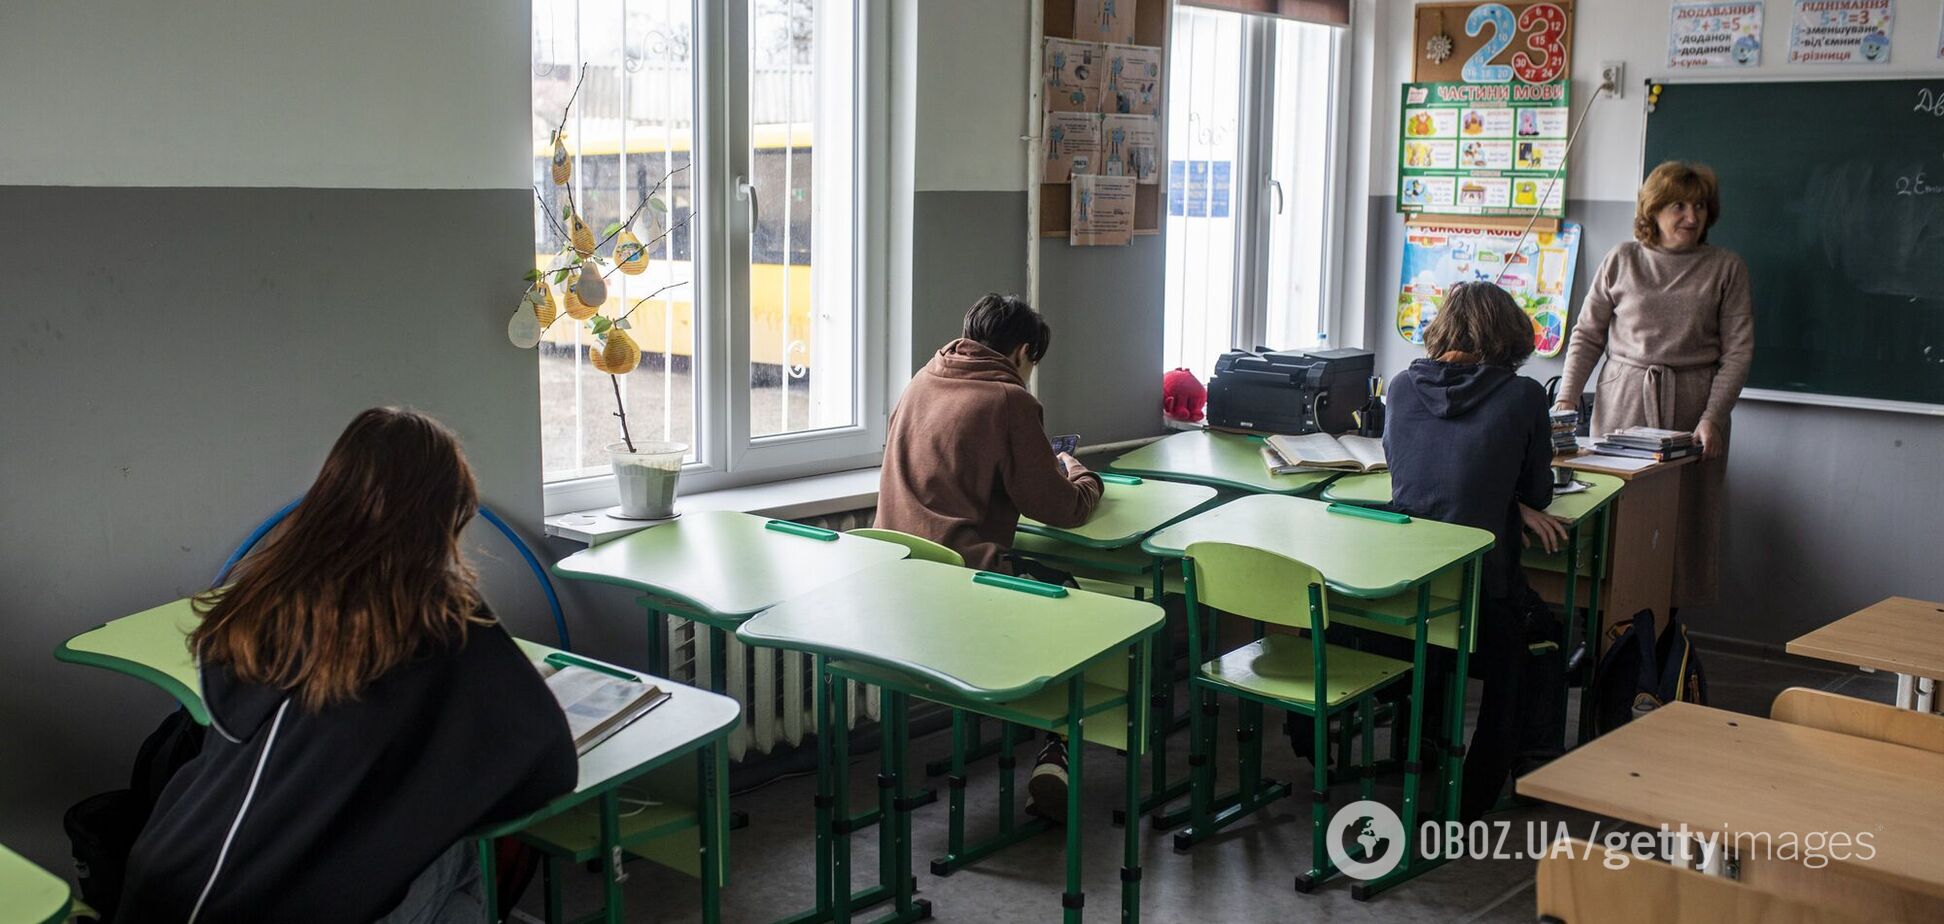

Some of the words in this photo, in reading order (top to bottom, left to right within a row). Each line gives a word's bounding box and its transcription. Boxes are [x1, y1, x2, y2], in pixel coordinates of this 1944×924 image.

[1677, 6, 1755, 19] ДОДАВАННЯ
[1438, 85, 1510, 101] ЧАСТИНИ
[1514, 84, 1563, 100] МОВИ
